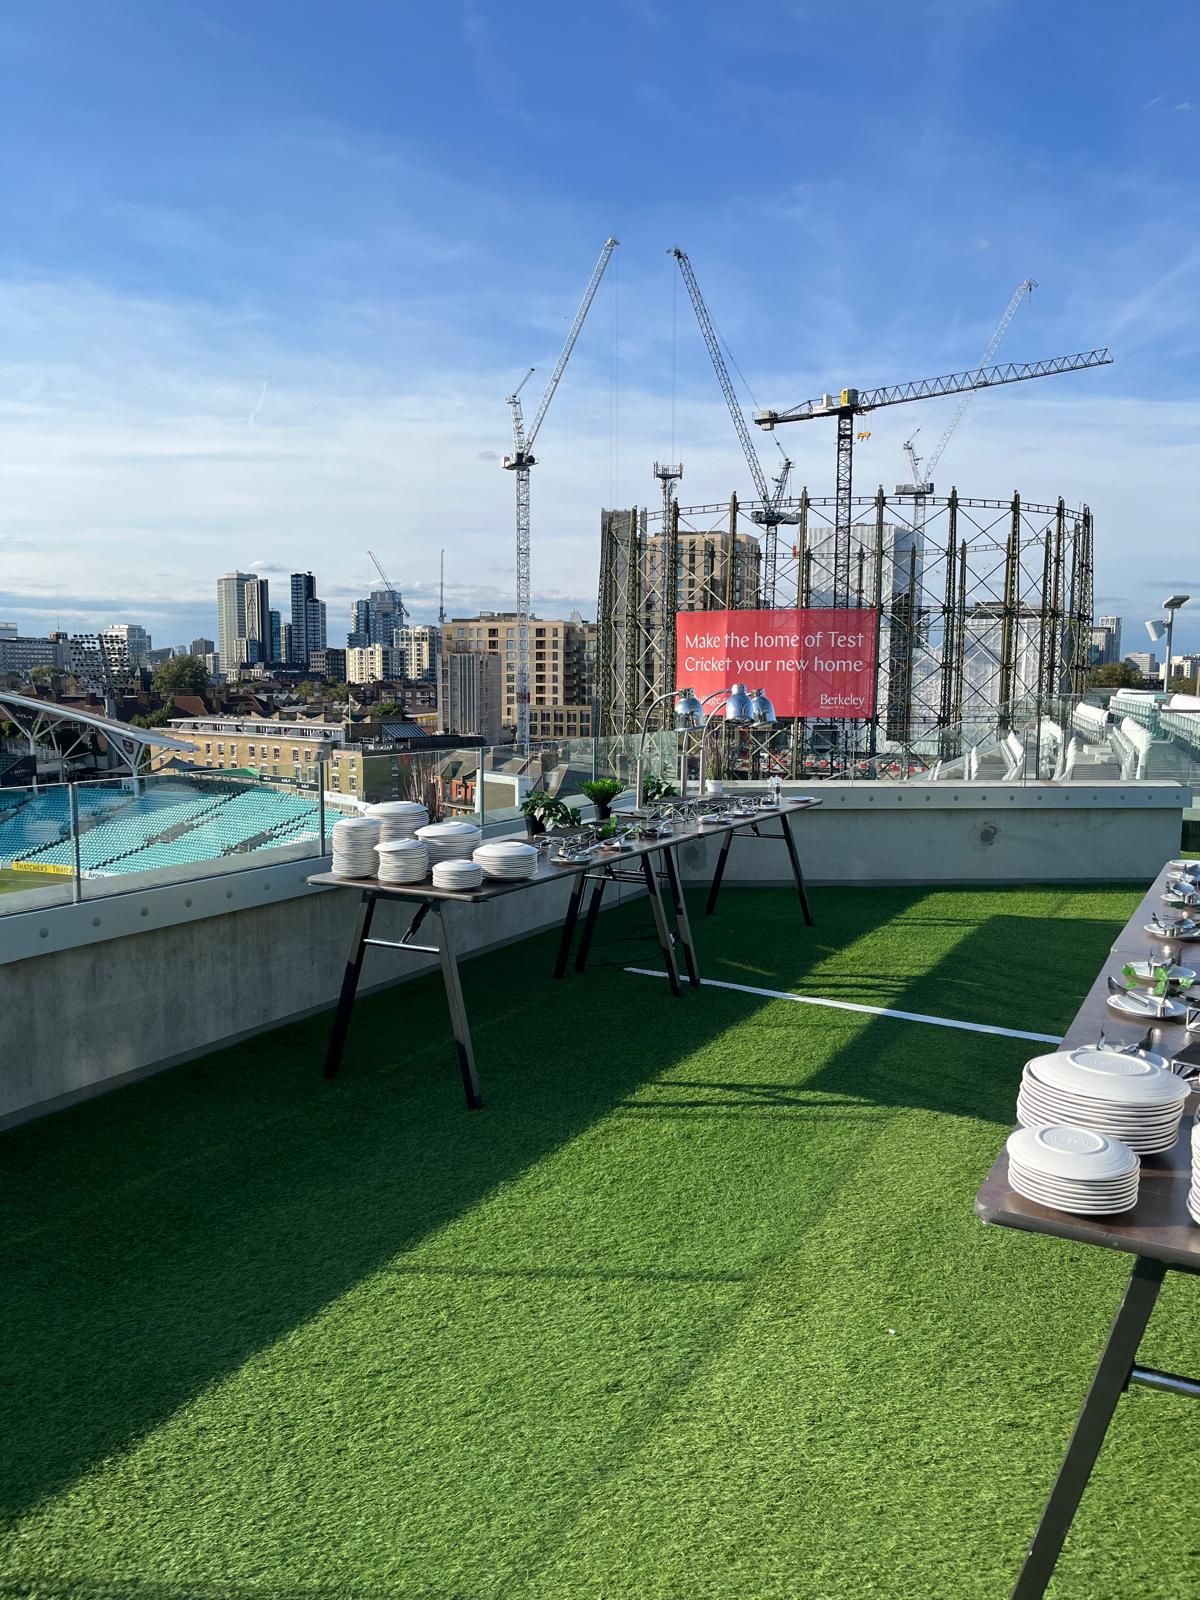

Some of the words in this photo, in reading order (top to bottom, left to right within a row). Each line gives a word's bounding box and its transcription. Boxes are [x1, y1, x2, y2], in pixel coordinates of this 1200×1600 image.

[685, 632, 721, 648] Make
[724, 632, 749, 648] the
[754, 632, 800, 648] home
[804, 631, 823, 648] of
[827, 631, 865, 648] Test
[685, 656, 731, 672] Cricket
[736, 660, 772, 675] your
[776, 660, 810, 672] new
[814, 656, 864, 672] home
[820, 693, 865, 709] Berkeley
[16, 863, 48, 871] THATCHERS
